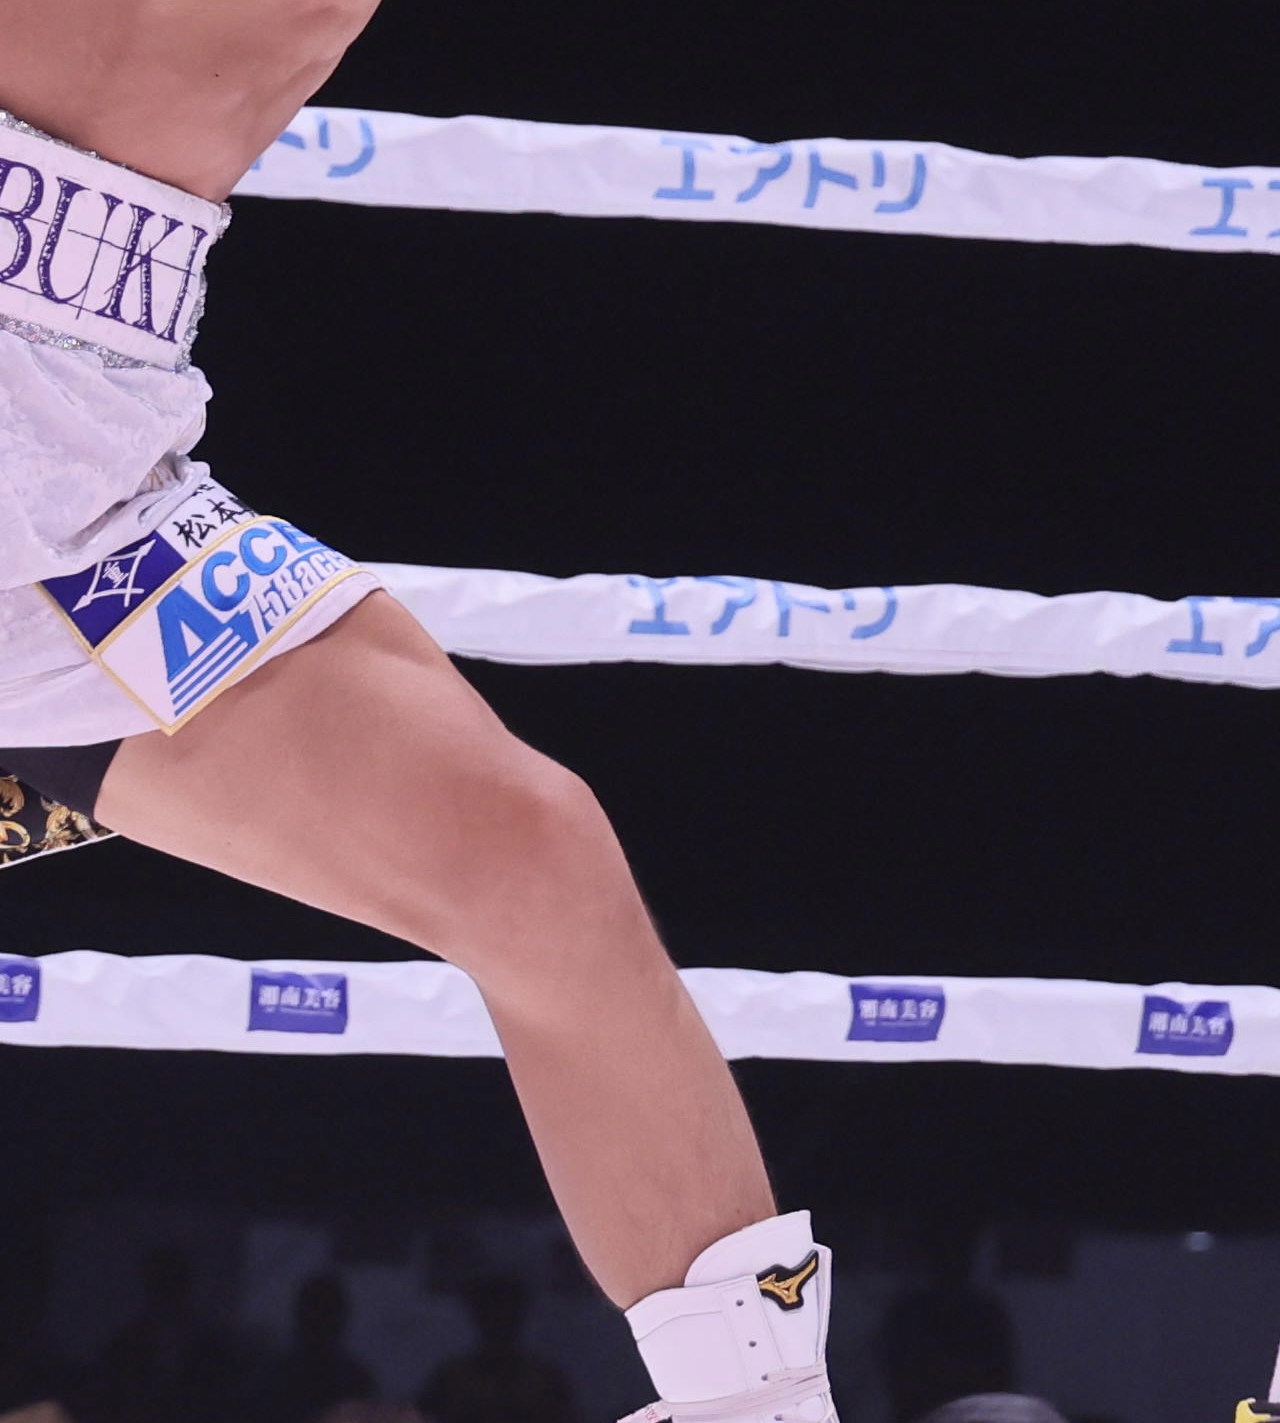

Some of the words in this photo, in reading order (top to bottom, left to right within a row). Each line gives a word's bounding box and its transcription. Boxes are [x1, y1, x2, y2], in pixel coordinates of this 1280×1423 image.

[654, 134, 928, 214] エアトリ
[626, 575, 898, 639] エアトリ
